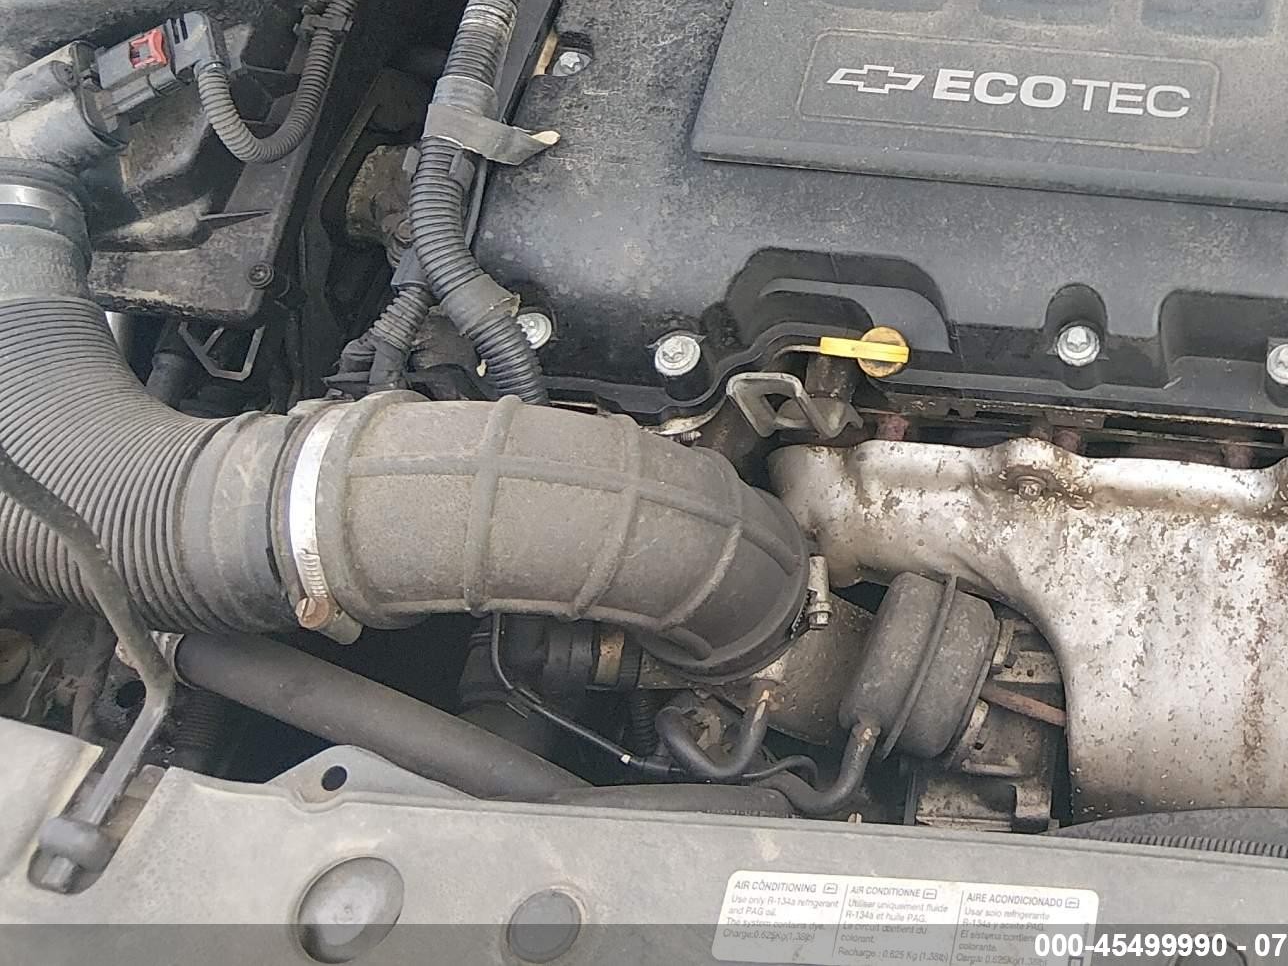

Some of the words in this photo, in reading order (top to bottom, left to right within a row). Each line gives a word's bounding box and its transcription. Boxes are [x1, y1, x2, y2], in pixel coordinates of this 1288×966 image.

[933, 69, 1191, 118] ECOTEC
[734, 880, 751, 891] AIR
[751, 880, 817, 893] CONDITIONING
[850, 885, 865, 894] AIR
[731, 895, 748, 904] Use
[749, 896, 764, 906] only
[767, 896, 796, 906] R-134a
[797, 898, 839, 909] refrigerant
[848, 898, 875, 908] Utiliser
[877, 901, 925, 912] uniquement
[926, 904, 949, 913] fluide
[966, 892, 987, 903] AIRE
[988, 894, 1063, 907] ACONDICIONADO
[727, 906, 744, 915] and
[745, 907, 764, 916] PAG
[845, 910, 874, 920] R-134a
[875, 912, 884, 920] et
[885, 912, 905, 922] huile
[964, 907, 984, 916] Usar
[1003, 909, 1051, 921] refrigerante
[726, 917, 741, 926] The
[742, 920, 772, 929] system
